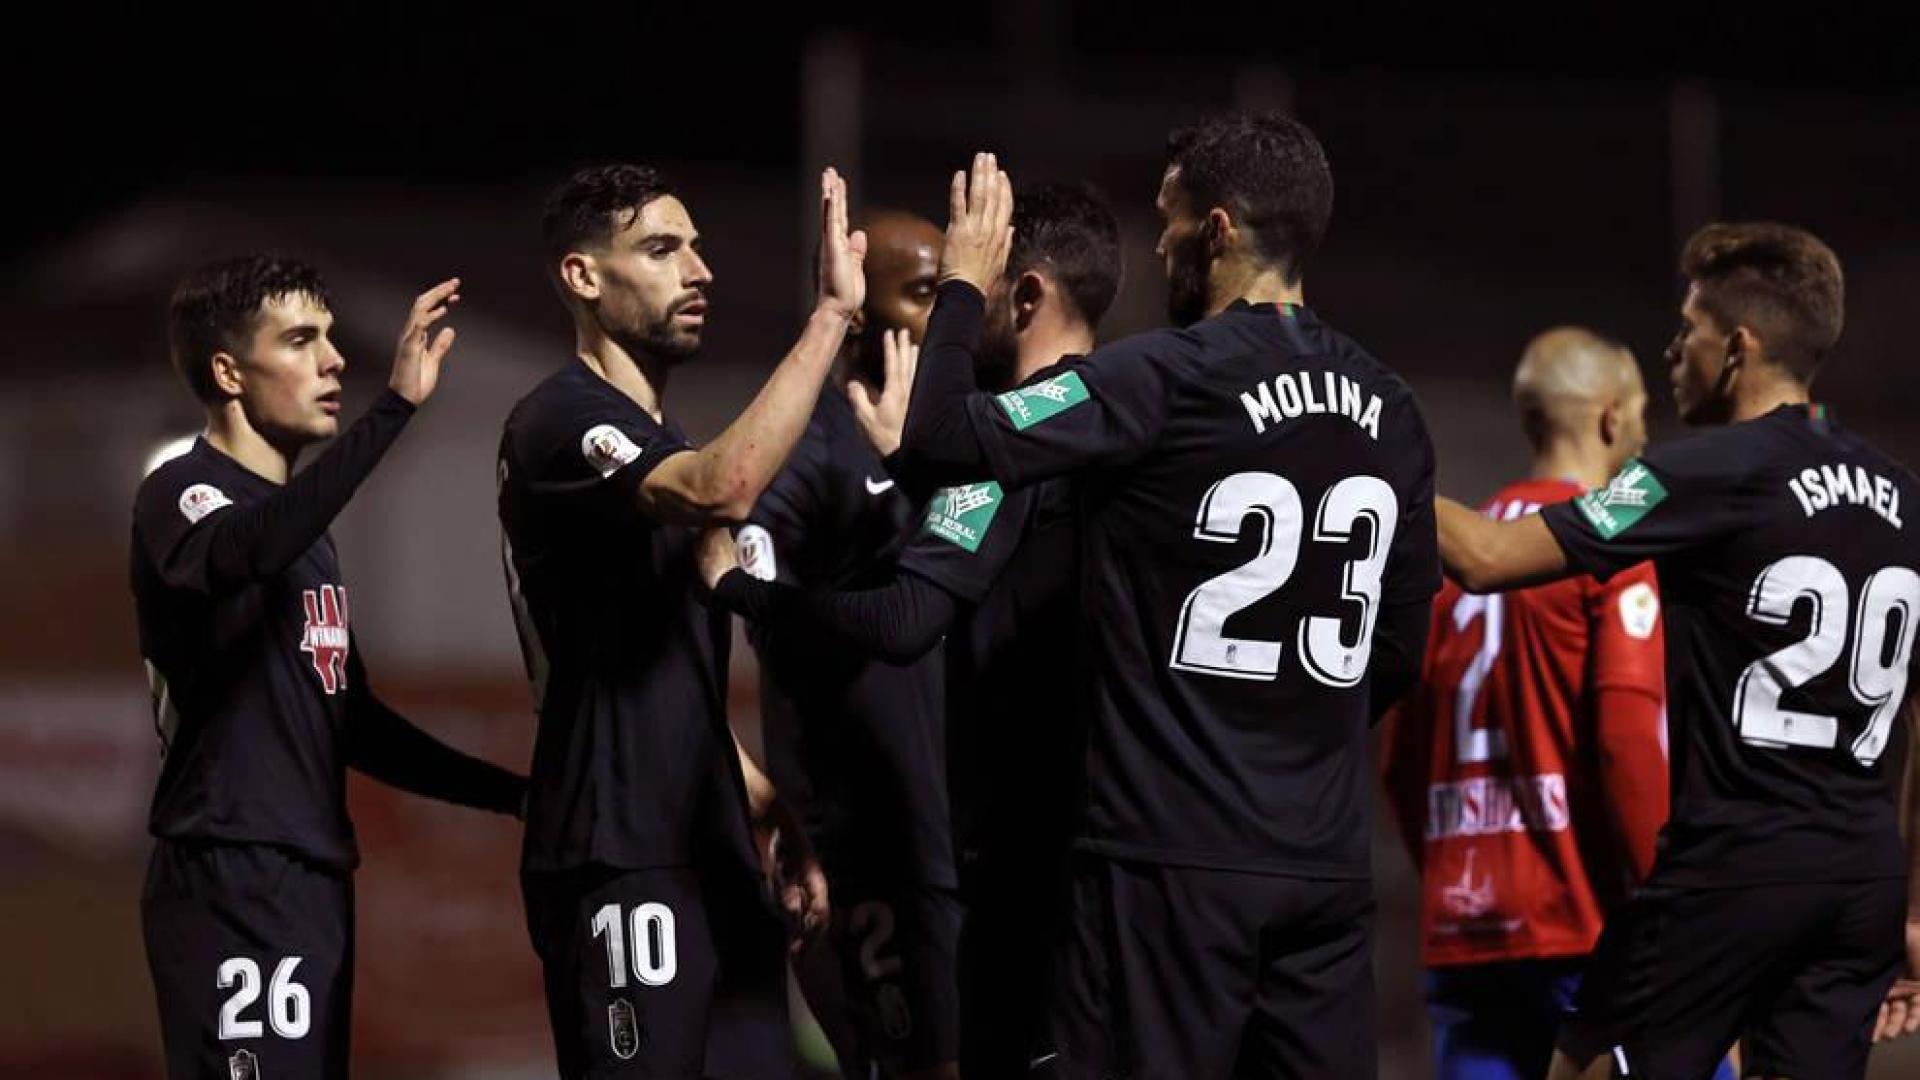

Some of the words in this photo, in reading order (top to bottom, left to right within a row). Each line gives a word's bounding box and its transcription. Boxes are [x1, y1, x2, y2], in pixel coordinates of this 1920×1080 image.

[1240, 371, 1383, 440] MOLINA
[1788, 463, 1903, 530] ISMAEL
[1169, 470, 1398, 687] 23
[1732, 555, 1920, 767] 29
[591, 902, 677, 988] 10
[216, 956, 311, 1040] 26
